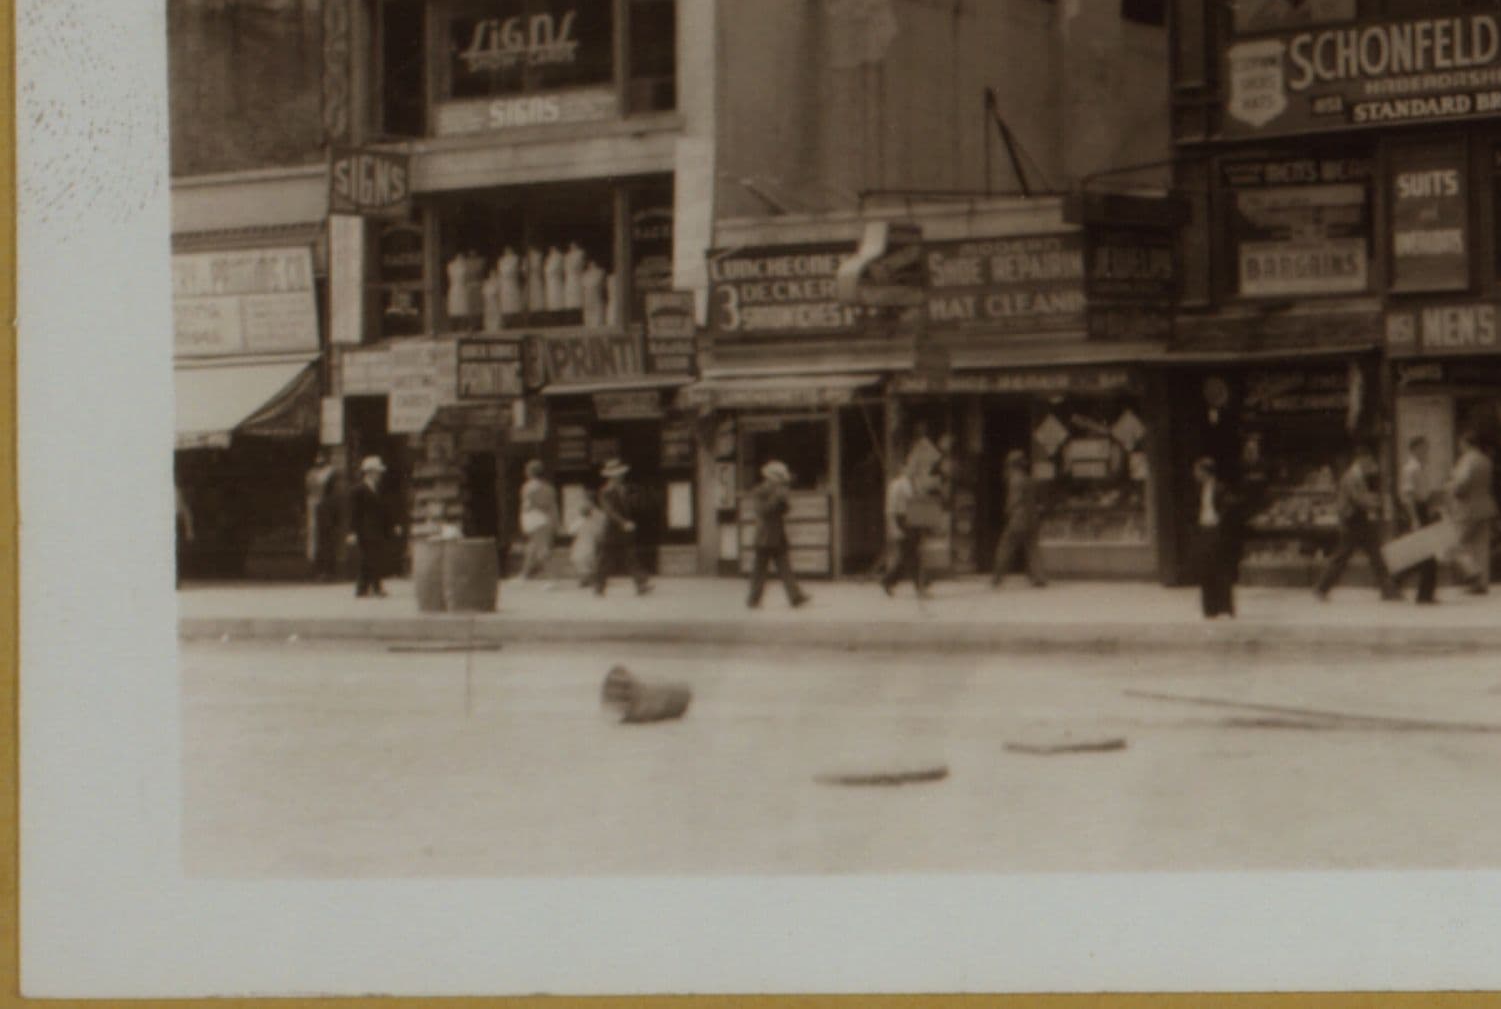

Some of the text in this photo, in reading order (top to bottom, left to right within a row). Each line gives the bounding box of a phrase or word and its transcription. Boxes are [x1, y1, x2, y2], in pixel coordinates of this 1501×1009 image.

[1289, 13, 1499, 92] SCHONFELD
[1353, 94, 1472, 125] STANDARD
[334, 154, 406, 207] SIGNS
[1396, 168, 1460, 199] SUITS
[1245, 252, 1359, 281] BARGAINS
[740, 280, 837, 303] DECKER
[716, 285, 742, 332] 3
[928, 295, 976, 322] HAT
